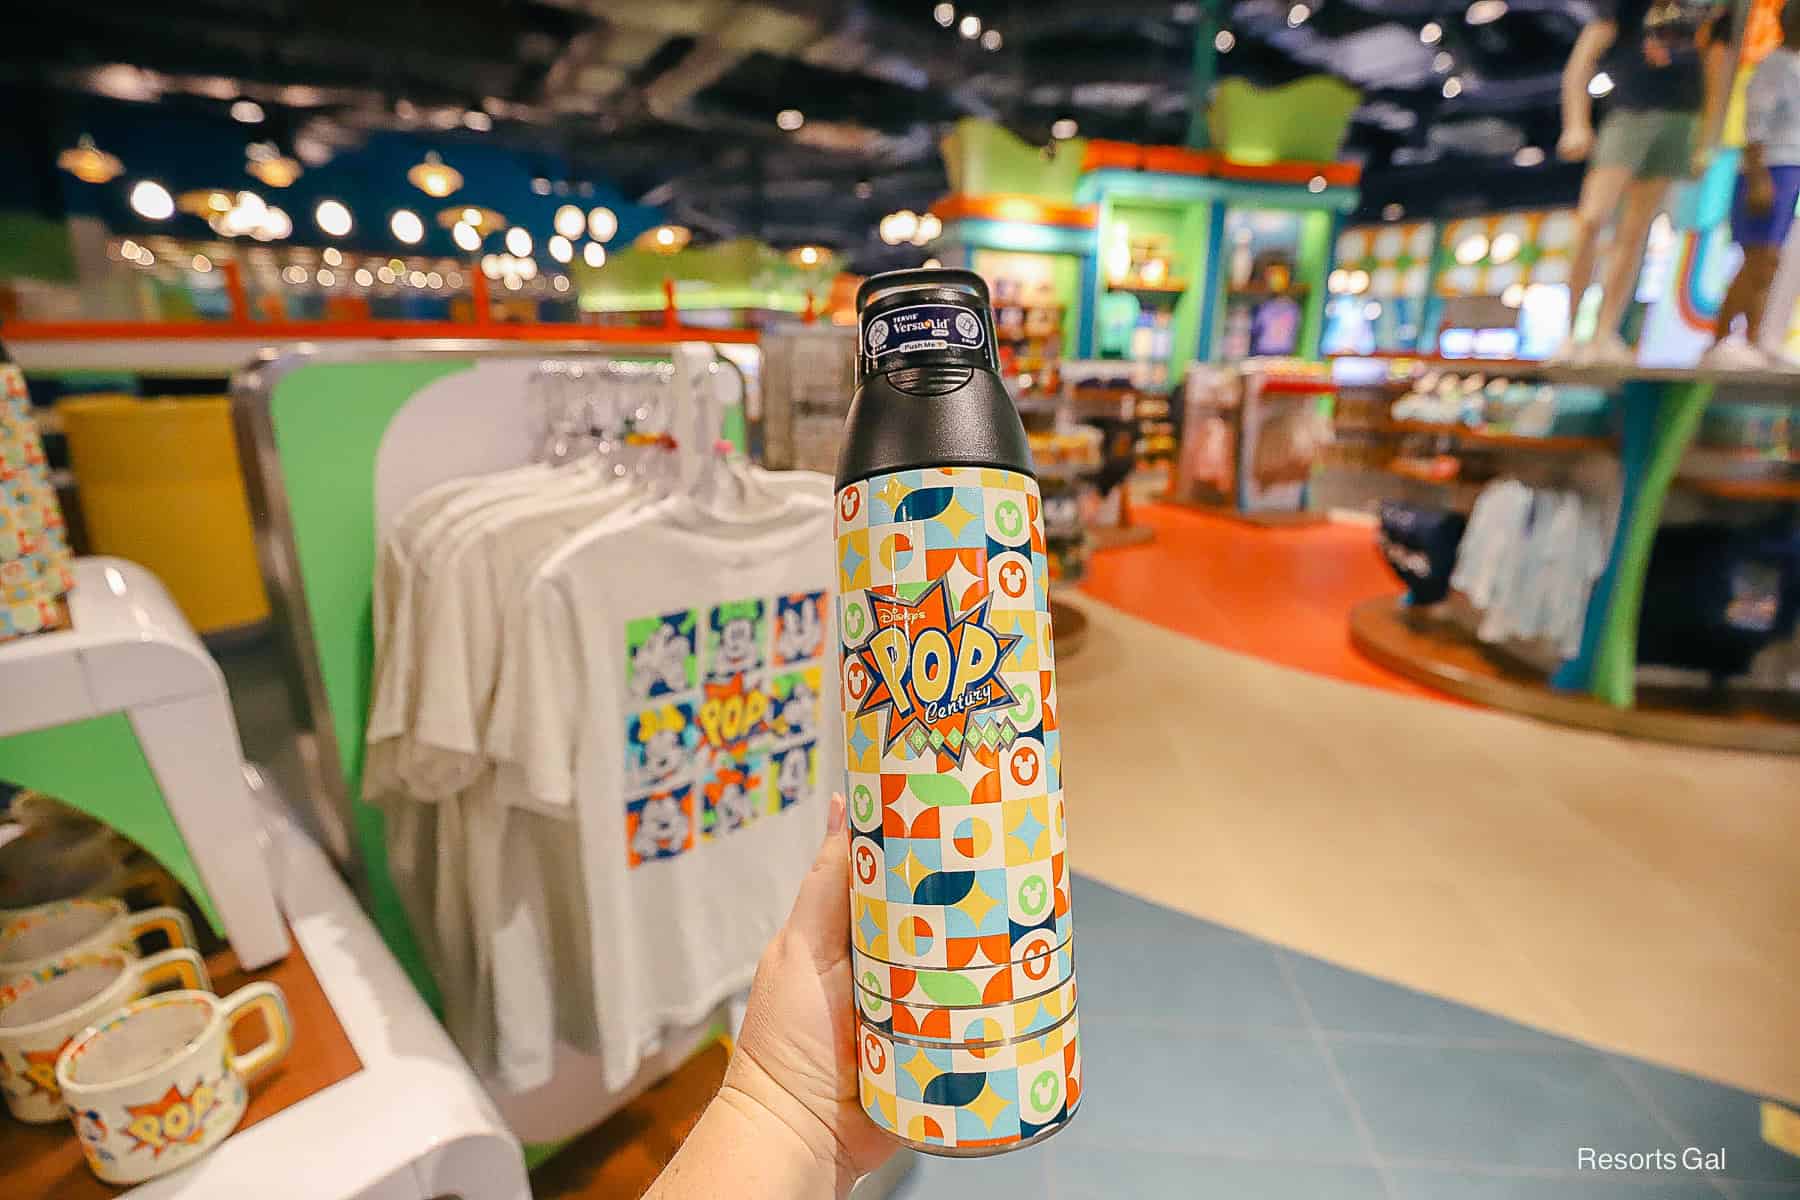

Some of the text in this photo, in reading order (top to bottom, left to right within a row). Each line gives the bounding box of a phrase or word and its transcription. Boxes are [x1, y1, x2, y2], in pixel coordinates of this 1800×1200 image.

[904, 341, 936, 351] Push Me
[868, 622, 998, 714] POP
[700, 688, 768, 748] POP
[925, 684, 992, 723] Century
[128, 1087, 214, 1150] POP
